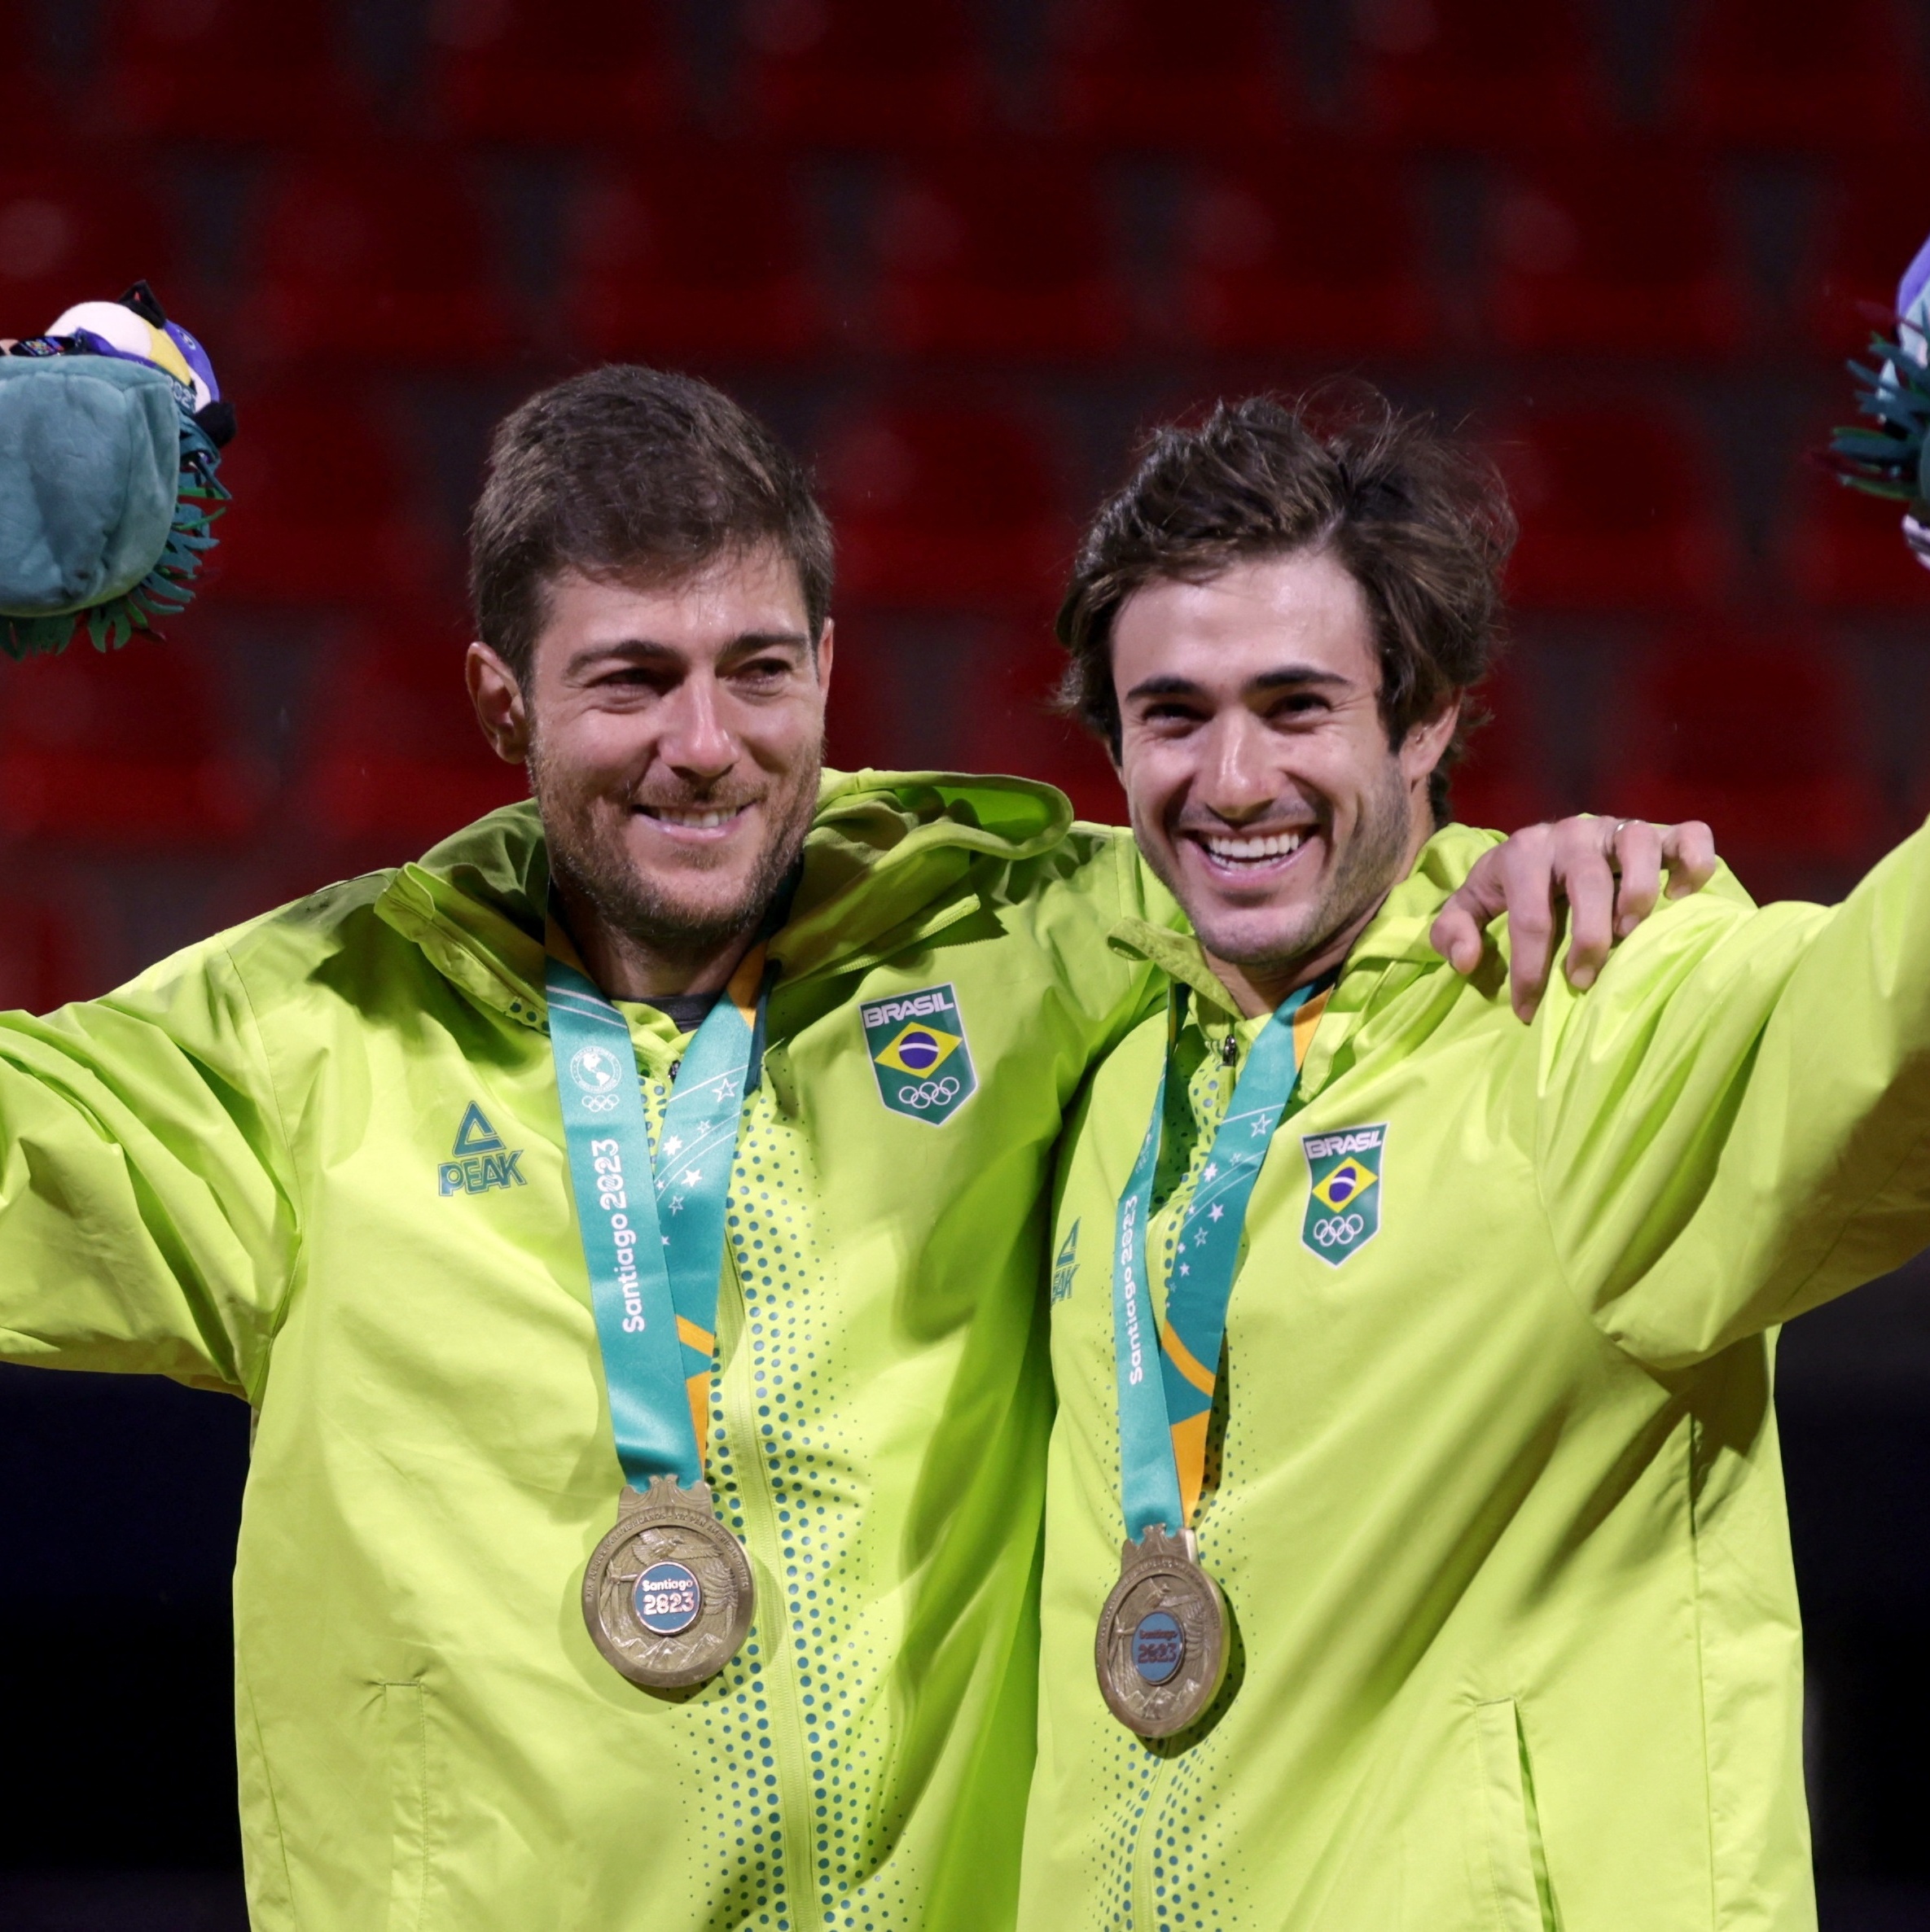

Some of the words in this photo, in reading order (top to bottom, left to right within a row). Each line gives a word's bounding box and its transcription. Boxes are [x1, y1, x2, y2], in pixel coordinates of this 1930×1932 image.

[862, 992, 954, 1028] BRASIL
[1305, 1131, 1382, 1159] BRASIL
[438, 1150, 528, 1197] PEAK
[591, 1138, 628, 1211] 2023
[1121, 1195, 1138, 1265] 2023
[611, 1213, 645, 1333] Santiago
[1051, 1264, 1081, 1306] EAK
[1124, 1266, 1143, 1386] Santiago
[642, 1579, 693, 1592] Santiago
[643, 1591, 695, 1615] 2023
